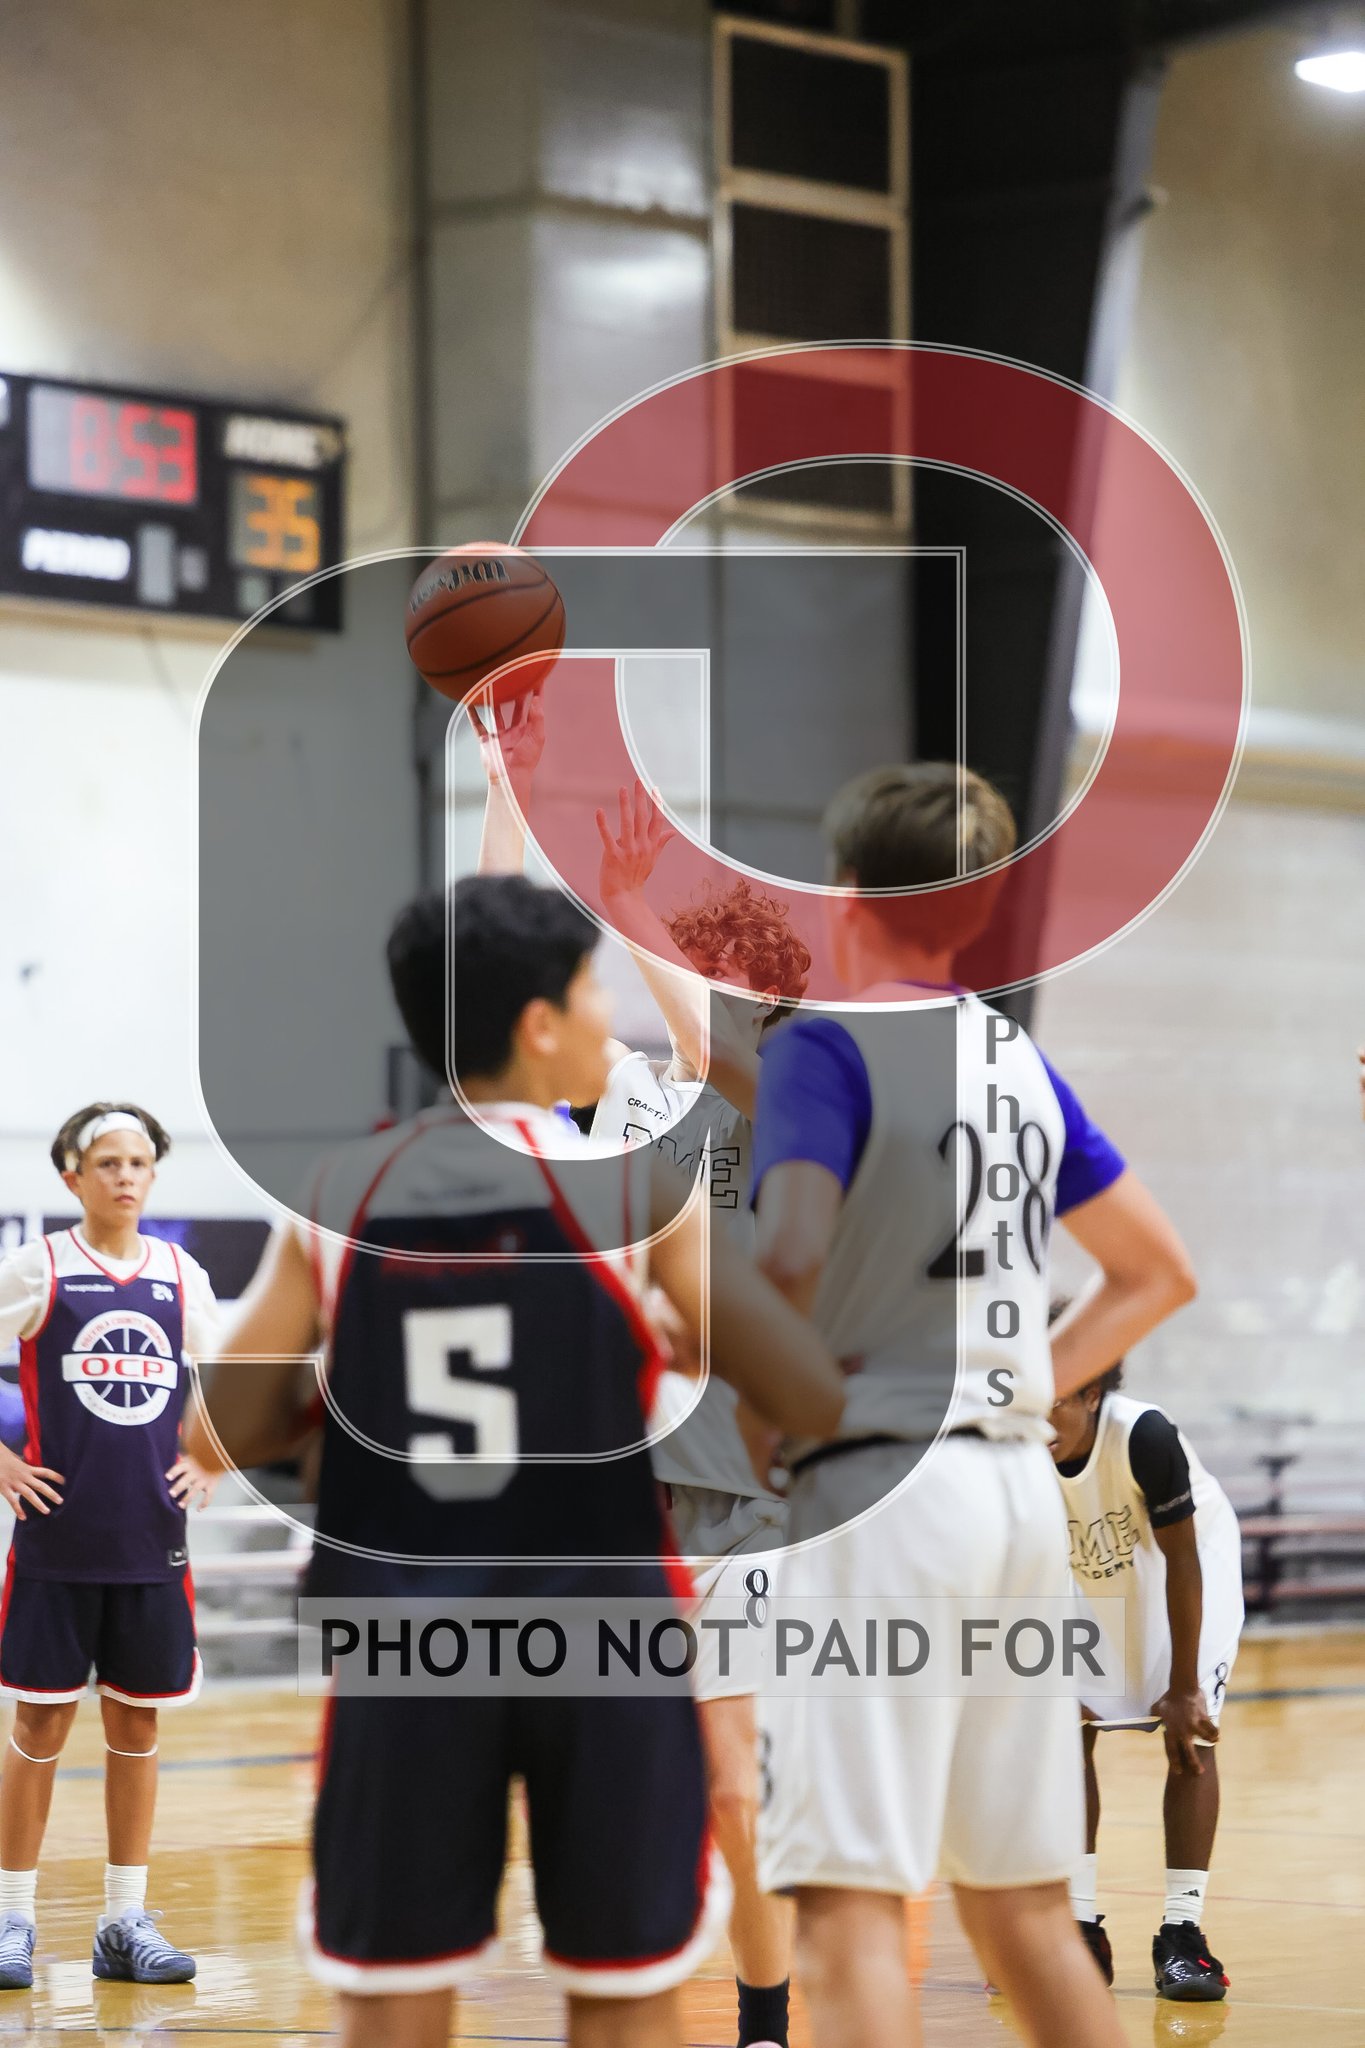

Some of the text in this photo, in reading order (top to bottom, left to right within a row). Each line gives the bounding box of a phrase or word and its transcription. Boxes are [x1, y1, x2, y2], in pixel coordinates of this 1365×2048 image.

[246, 472, 321, 574] 35
[627, 1097, 661, 1117] CRAFT
[928, 1120, 1049, 1278] 28
[81, 1357, 164, 1378] OCP
[405, 1304, 519, 1501] 5
[1067, 1504, 1141, 1566] ME
[744, 1568, 769, 1629] 8
